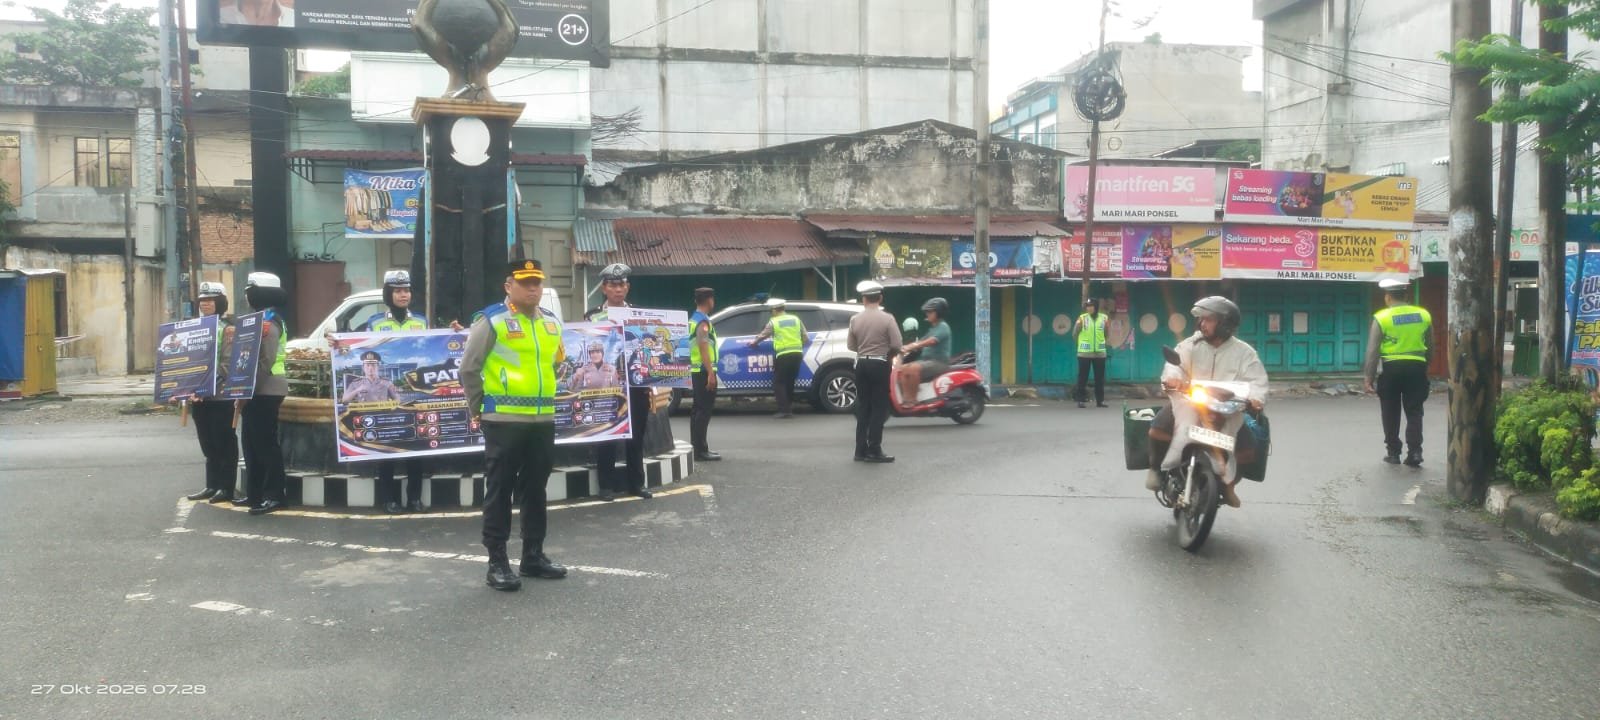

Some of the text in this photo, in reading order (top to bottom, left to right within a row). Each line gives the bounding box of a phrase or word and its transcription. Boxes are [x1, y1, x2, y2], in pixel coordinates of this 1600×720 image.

[562, 23, 585, 35] 21+
[368, 175, 417, 191] Mika
[1086, 175, 1196, 193] martfren 5G
[1238, 185, 1273, 195] Streaming
[1231, 194, 1278, 204] bebas loading
[1101, 210, 1179, 218] MARI MARI PONSEL
[1225, 234, 1294, 246] Sekarang beda.
[1320, 235, 1377, 246] BUKTIKAN
[1321, 246, 1375, 257] BEDANYA
[1277, 271, 1357, 280] MARI MARI PONSEL
[423, 368, 460, 385] PAT
